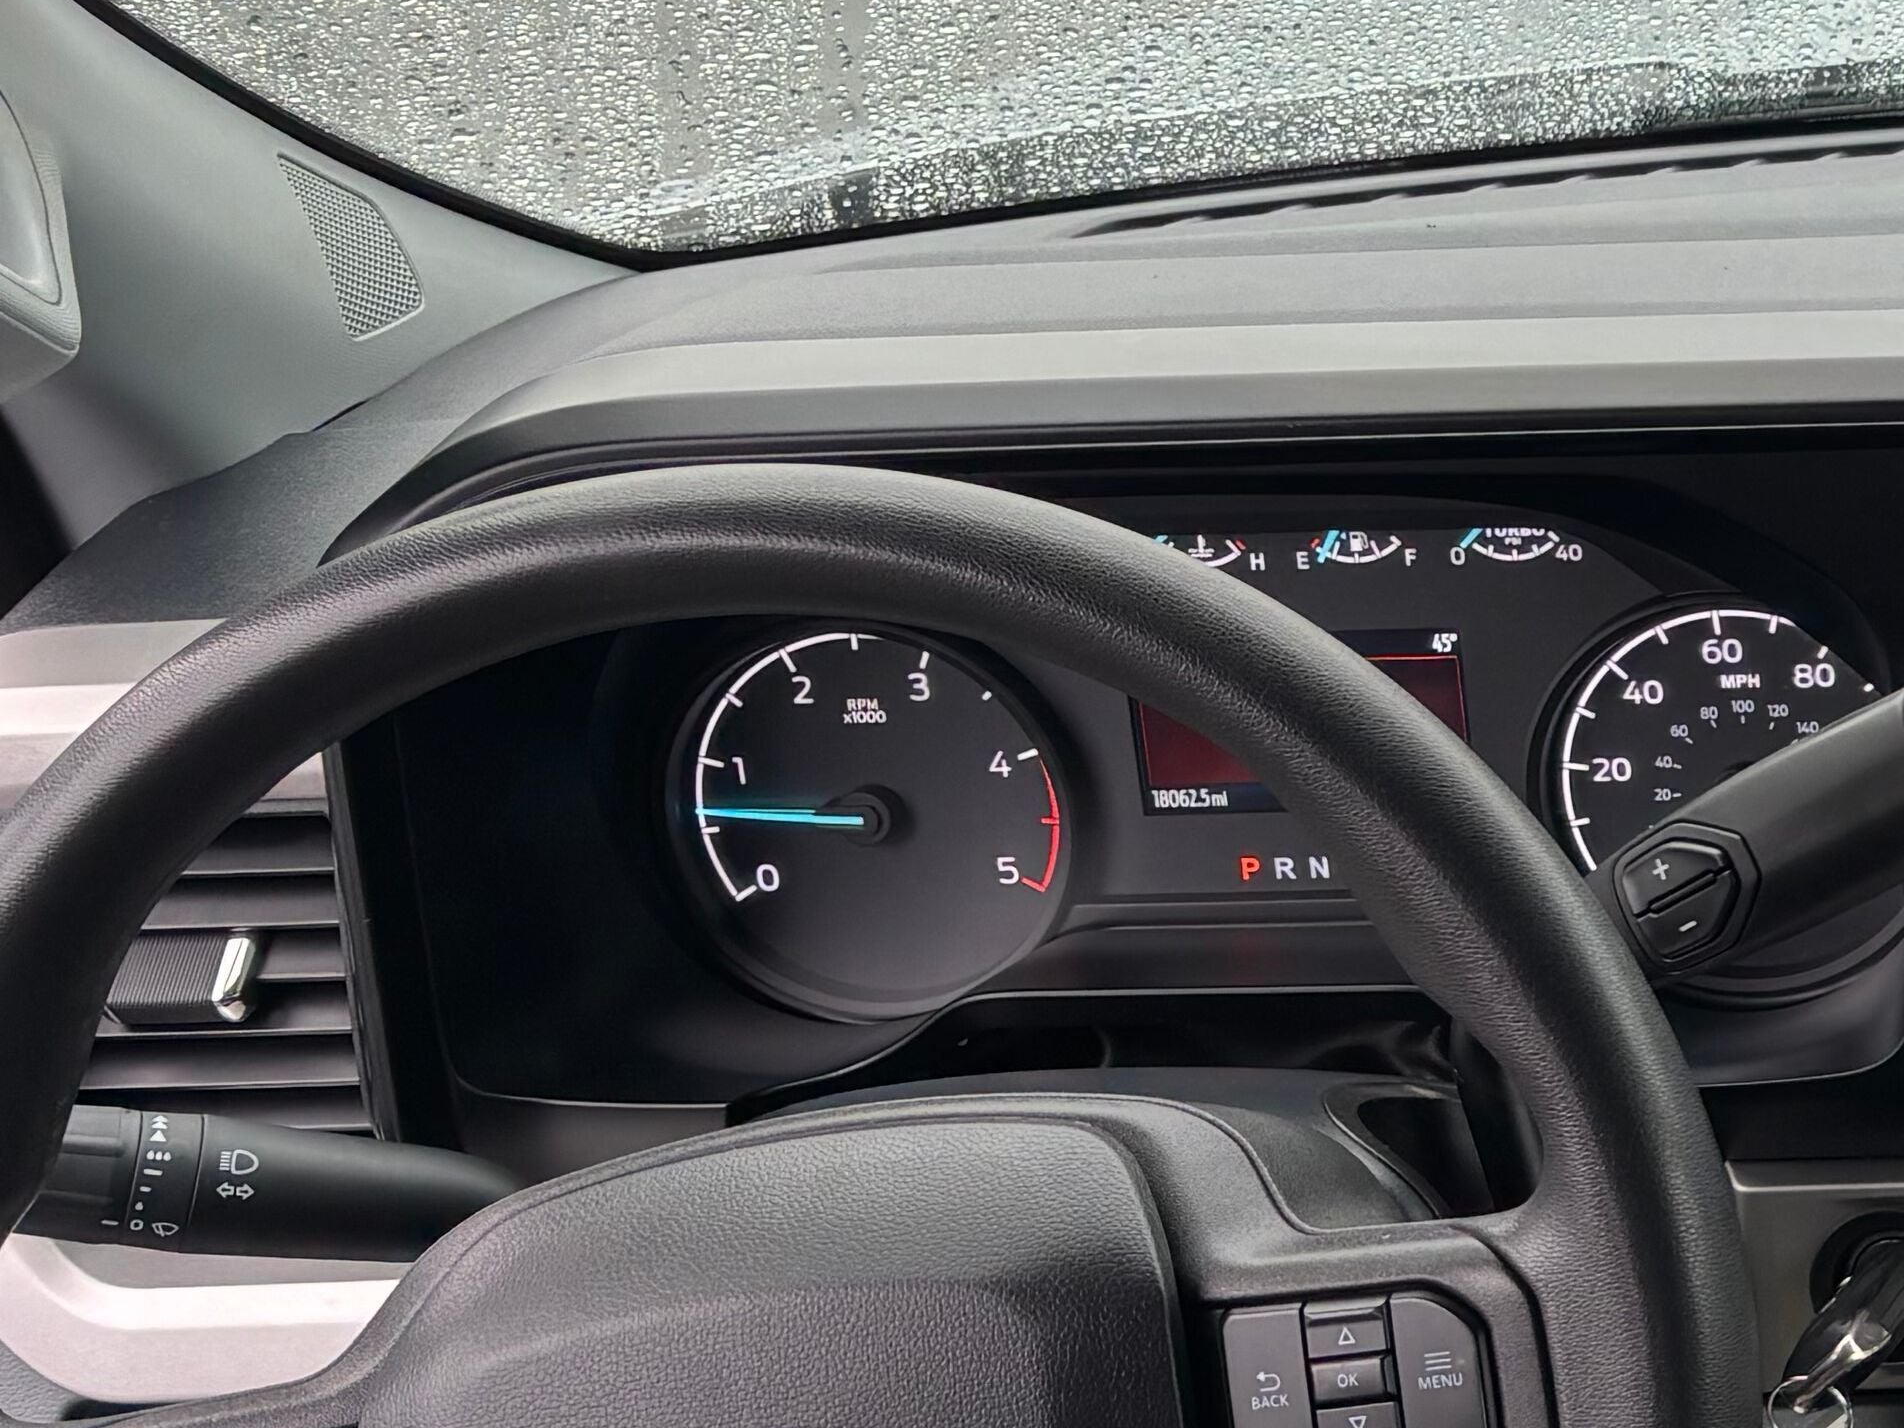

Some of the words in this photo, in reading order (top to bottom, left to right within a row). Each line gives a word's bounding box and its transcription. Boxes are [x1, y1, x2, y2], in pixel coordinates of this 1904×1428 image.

[1250, 553, 1266, 571] H
[1297, 551, 1310, 570] E
[1405, 548, 1417, 567] F
[1555, 544, 1583, 562] 40
[1702, 639, 1743, 664] 60
[1720, 674, 1761, 690] MPH
[1794, 663, 1836, 688] 80
[792, 676, 814, 705] 2
[908, 672, 931, 702] 3
[1623, 680, 1664, 705] 40
[846, 698, 879, 711] RPM
[1700, 706, 1719, 721] 80
[1731, 700, 1755, 714] 100
[1767, 704, 1790, 719] 120
[843, 710, 887, 725] x1000
[1670, 724, 1690, 739] 60
[731, 756, 748, 785] 1
[988, 750, 1012, 778] 4
[1592, 757, 1633, 782] 20
[1654, 755, 1673, 768] 40
[1653, 788, 1672, 802] 20
[996, 856, 1020, 885] 5
[1240, 856, 1260, 880] P
[1273, 857, 1297, 880] R
[1308, 856, 1330, 879] N
[1337, 1373, 1359, 1388] OK
[1418, 1372, 1463, 1390] MENU
[1251, 1394, 1289, 1410] BACK
